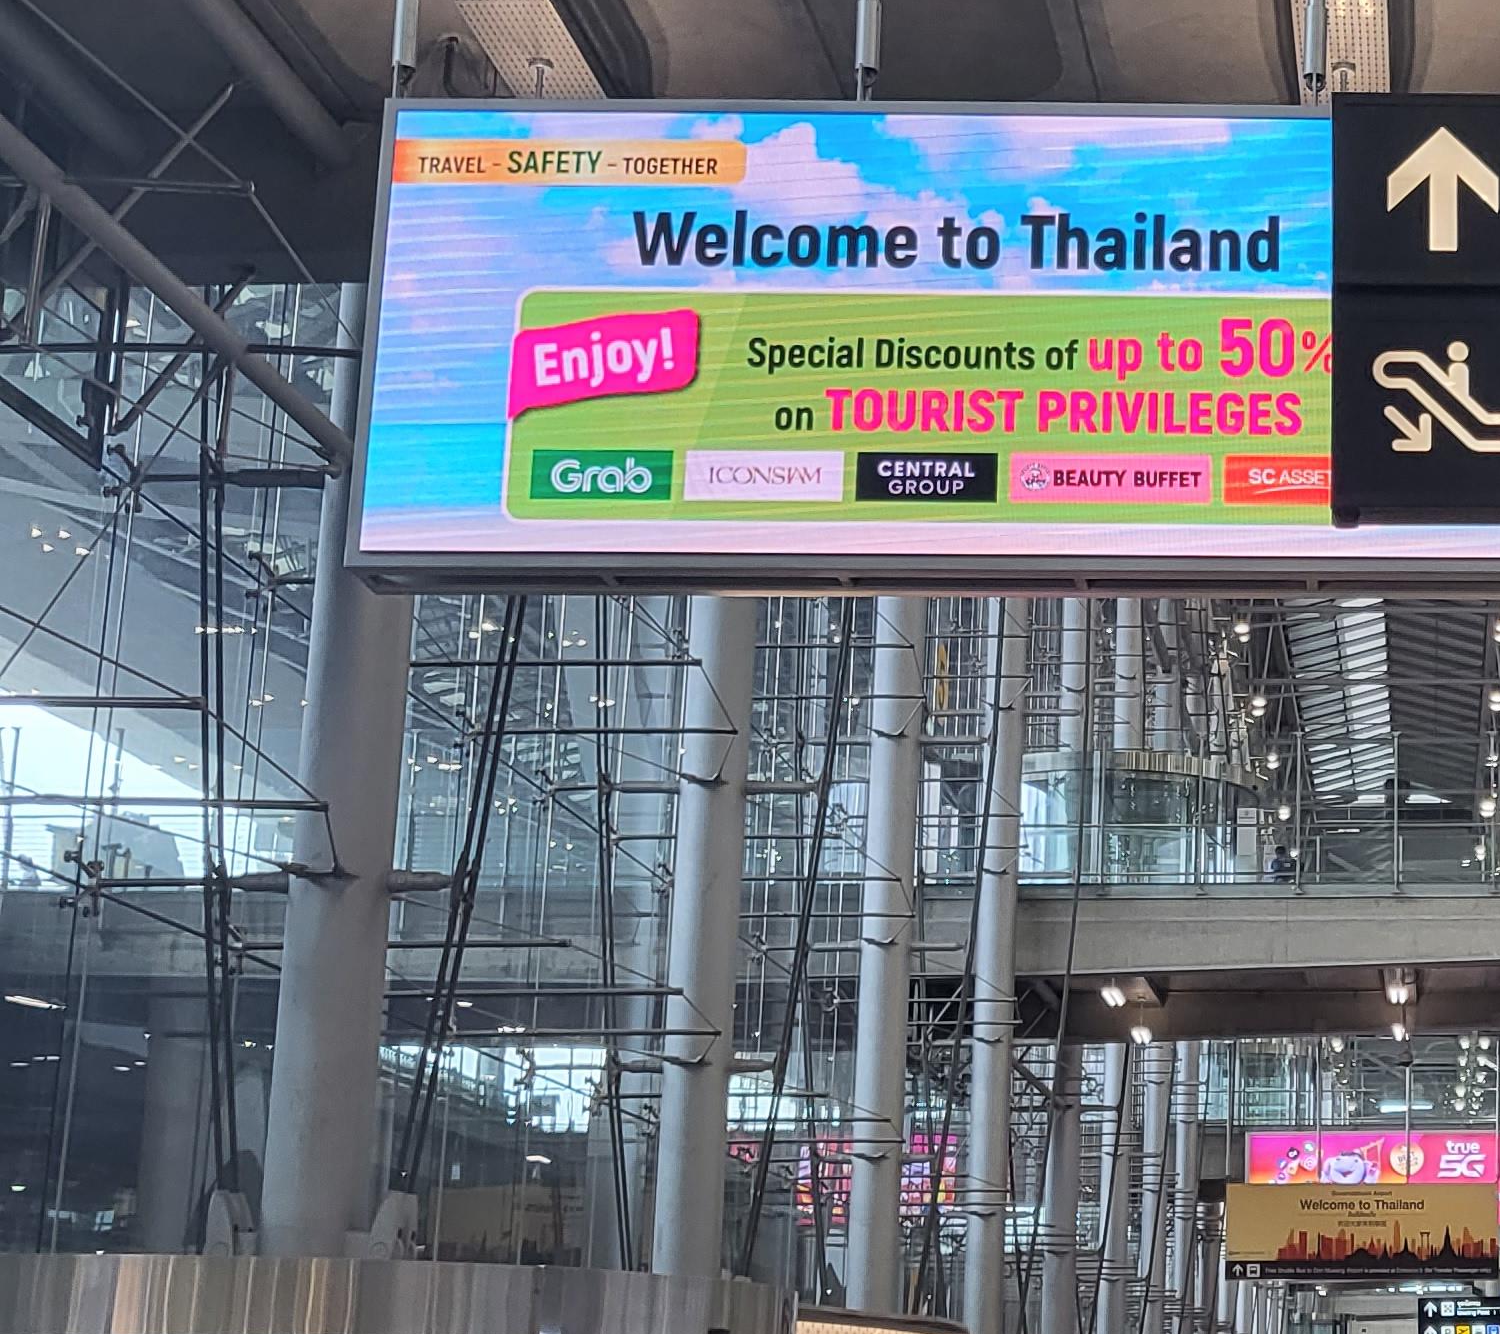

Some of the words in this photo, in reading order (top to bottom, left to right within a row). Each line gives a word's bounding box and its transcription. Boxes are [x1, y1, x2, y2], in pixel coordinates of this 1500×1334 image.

[418, 156, 486, 174] TRAVEL
[507, 150, 602, 174] SAFETY
[623, 156, 718, 175] TOGETHER
[633, 210, 919, 268] Welcome
[937, 216, 1001, 268] to
[1020, 212, 1280, 273] Thailand
[533, 327, 676, 388] Enjoy!
[747, 337, 863, 374] Special
[875, 338, 1035, 371] Discounts
[1046, 338, 1080, 371] of
[1088, 336, 1142, 381] up
[1157, 332, 1203, 371] to
[1219, 317, 1332, 378] 50%
[775, 405, 814, 431] on
[824, 388, 1025, 434] TOURIST
[1036, 390, 1302, 437] PRIVILEGES
[551, 457, 653, 493] Grab
[709, 466, 822, 485] ICONSIAM
[877, 461, 976, 479] CENTRAL
[1053, 469, 1126, 488] BEAUTY
[1134, 469, 1203, 488] BUFFET
[1248, 468, 1275, 485] SC
[888, 478, 964, 495] GROUP
[1446, 1140, 1480, 1154] true
[1437, 1154, 1487, 1178] 5G
[1299, 1199, 1355, 1210] Welcome
[1359, 1200, 1370, 1210] to
[1374, 1199, 1425, 1210] Thailand
